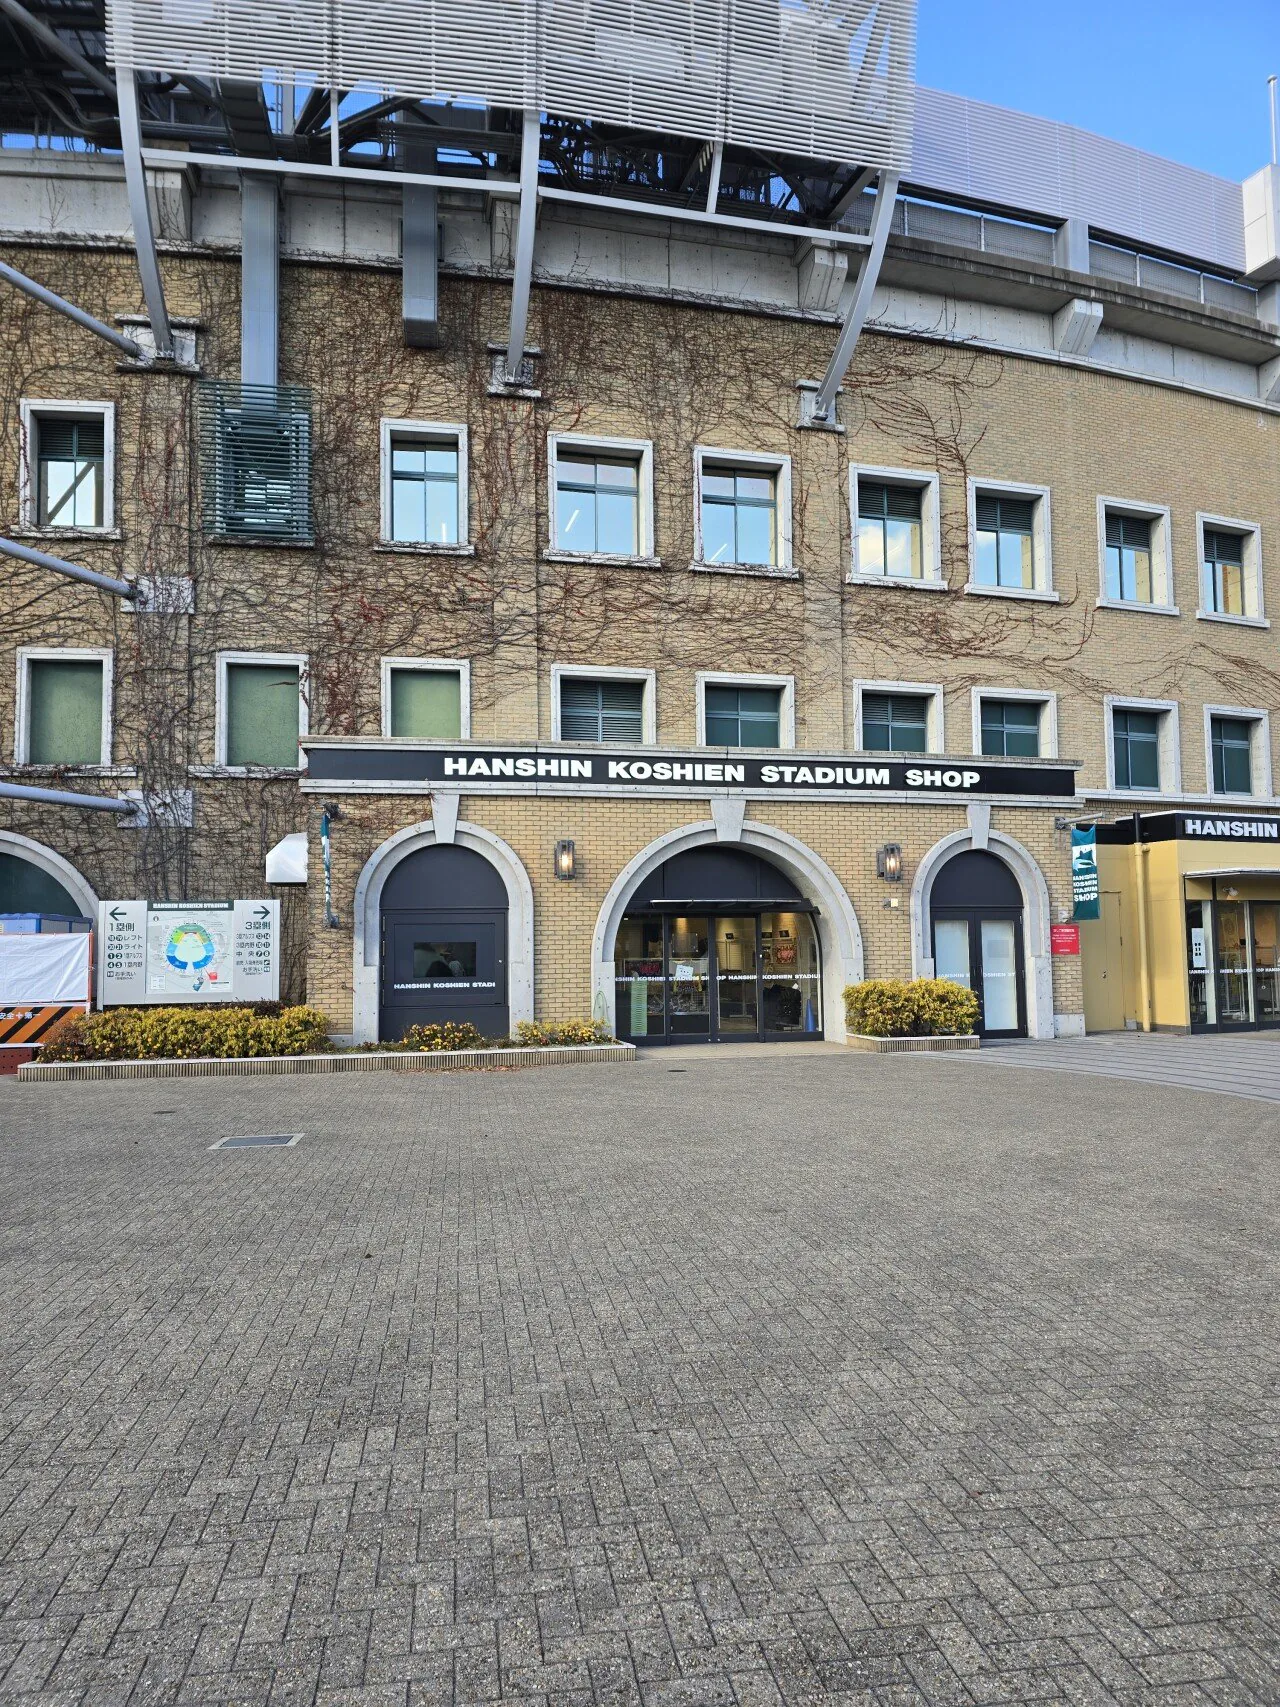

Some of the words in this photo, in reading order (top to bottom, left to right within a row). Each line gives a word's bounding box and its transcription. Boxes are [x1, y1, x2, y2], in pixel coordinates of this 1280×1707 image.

[444, 757, 592, 778] HANSHIN
[608, 761, 745, 782] KOSHIEN
[760, 765, 890, 785] STADIUM
[905, 769, 980, 788] SHOP
[1184, 819, 1279, 838] HANSHIN
[1074, 892, 1098, 902] SHOP
[109, 922, 135, 932] 1塁側
[245, 921, 271, 930] 3塁側
